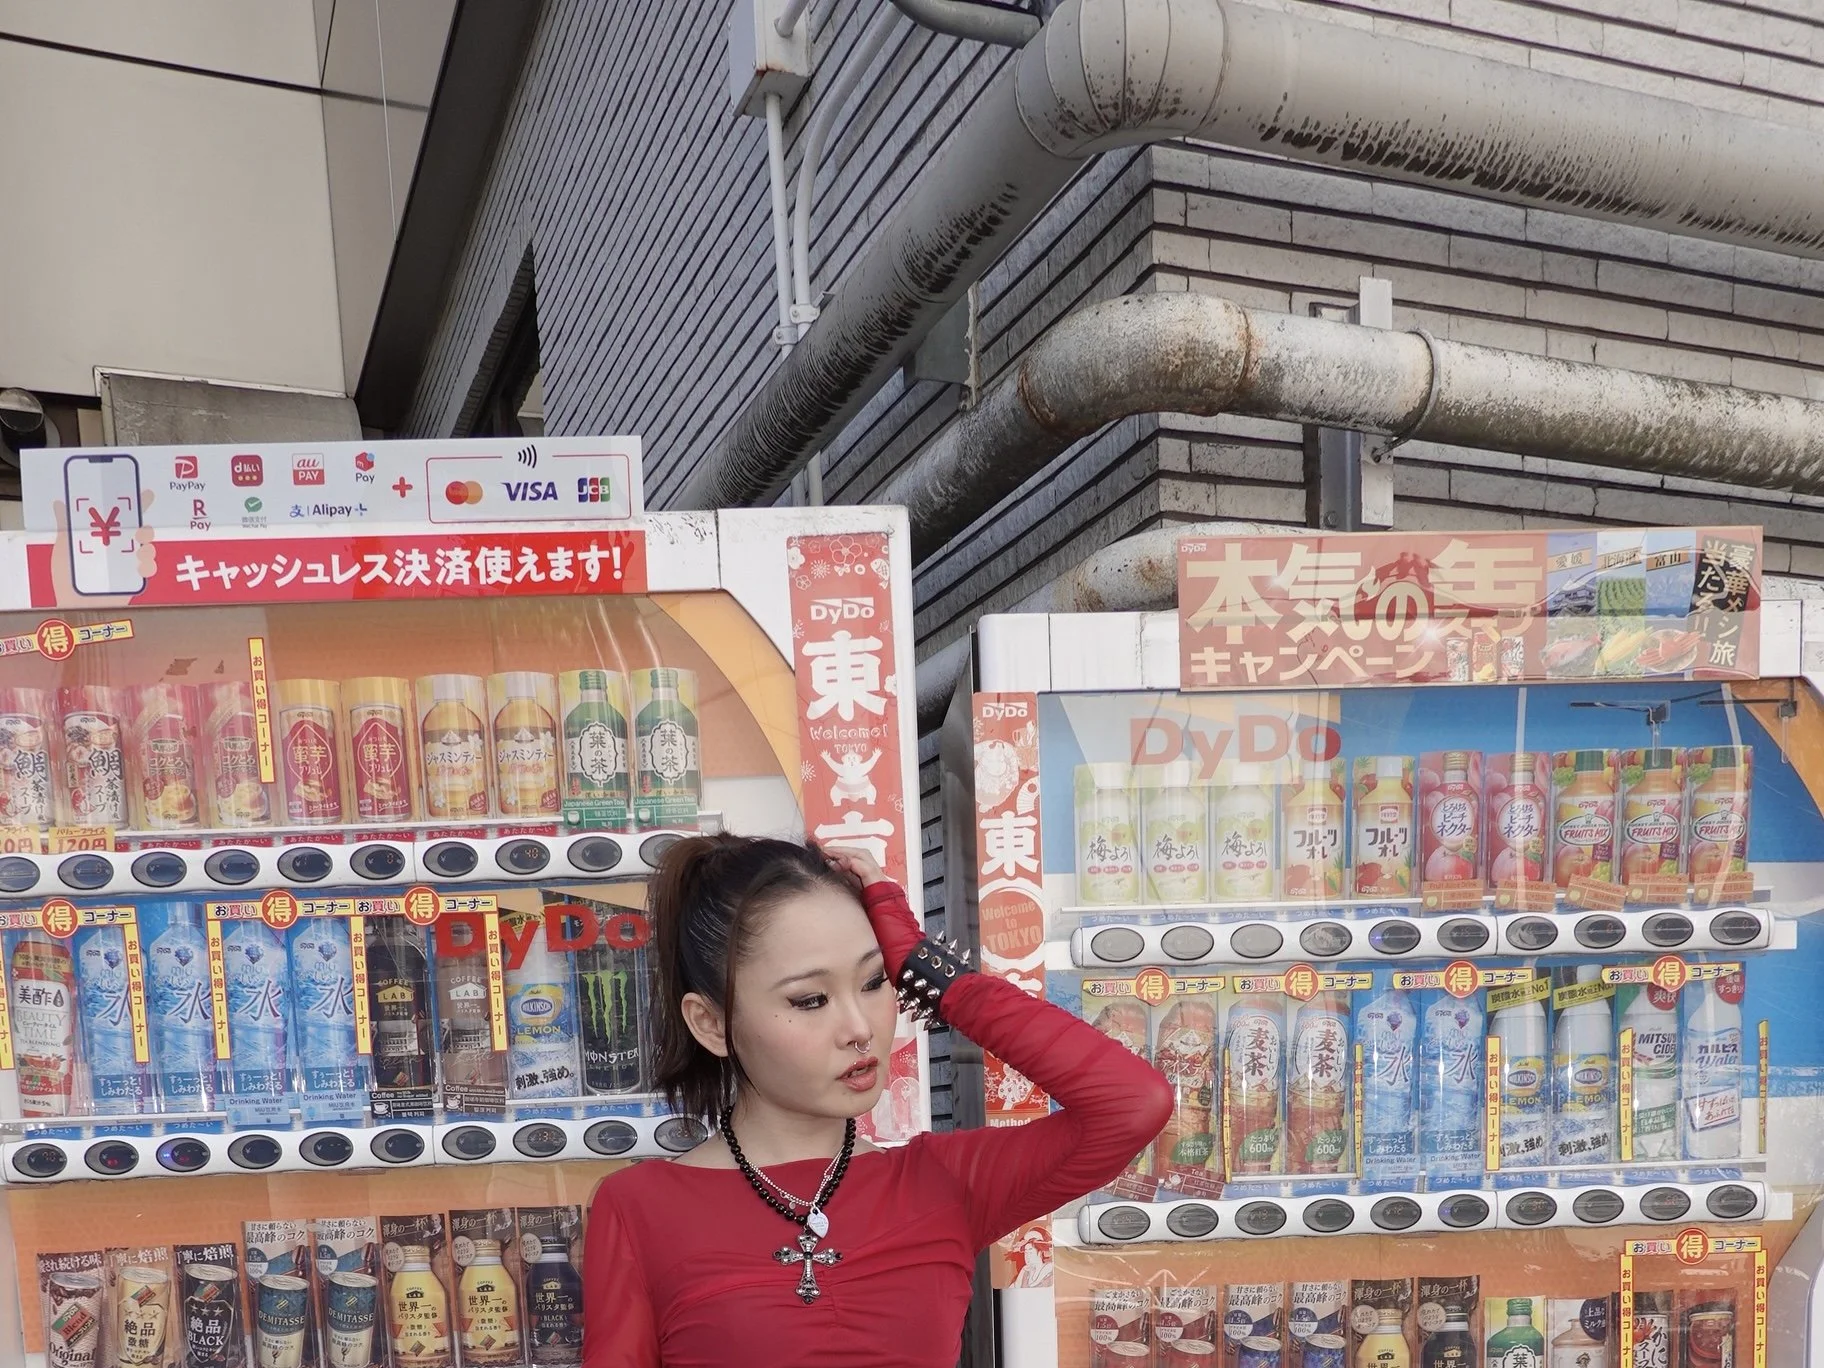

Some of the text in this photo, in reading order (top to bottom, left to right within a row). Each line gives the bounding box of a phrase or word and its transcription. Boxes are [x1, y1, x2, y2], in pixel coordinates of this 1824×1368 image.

[297, 457, 319, 468] au
[298, 472, 319, 482] PAY
[355, 473, 375, 483] Pay
[170, 482, 206, 491] PayPay
[501, 482, 558, 501] VISA
[577, 482, 611, 498] JCB
[193, 499, 207, 516] R
[190, 520, 211, 531] Pay
[1181, 543, 1207, 554] DyDo
[1653, 551, 1682, 567] 富山
[810, 598, 875, 624] DyDo
[1190, 644, 1434, 684] キャンペーン
[802, 630, 887, 721] 東
[252, 656, 271, 766] お買い得コーナー
[982, 703, 1028, 720] DyDo
[810, 724, 888, 741] Welcome!
[499, 749, 554, 762] ジャスミンティー
[589, 731, 608, 775] 葉の茶
[660, 729, 679, 773] 葉の茶
[834, 743, 867, 754] TOKYO
[1130, 715, 1342, 780] DyDo
[427, 751, 482, 764] ジャスミンティー
[1294, 828, 1337, 848] フルーツ
[1366, 827, 1408, 846] フルーツ
[1437, 823, 1472, 837] ネクター
[1502, 824, 1539, 838] ネクター
[1564, 828, 1608, 839] FRUITS MIX
[1632, 826, 1676, 837] FRUITS MIX
[1699, 825, 1743, 835] FRUITS MIX
[980, 810, 1040, 877] 東
[982, 900, 1035, 922] Welcome
[1006, 918, 1018, 929] to
[987, 925, 1042, 953] TOKYO
[353, 933, 367, 1038] お買い得コーナー
[450, 975, 482, 984] COFFEE
[488, 930, 502, 1035] お買い得コーナー
[128, 941, 145, 1047] お買い得コーナー
[210, 938, 226, 1043] お買い得コーナー
[311, 976, 353, 1018] 水
[169, 981, 212, 1024] 水
[238, 979, 282, 1021] 水
[16, 1010, 67, 1027] BEAUTY
[22, 1026, 57, 1040] TIME
[517, 1026, 561, 1035] LEMON
[1246, 1028, 1270, 1076] 麦茶
[1313, 1029, 1337, 1078] 麦茶
[1698, 1043, 1738, 1055] カルピス
[1378, 1046, 1412, 1086] 水
[1445, 1044, 1477, 1084] 水
[100, 1086, 143, 1096] しみわたる
[172, 1084, 214, 1093] しみわたる
[241, 1081, 283, 1091] しみわたる
[313, 1079, 355, 1089] しみわたる
[230, 1096, 282, 1106] Drinking Water
[304, 1093, 335, 1101] Drinking
[1569, 1094, 1608, 1105] LEMON
[1366, 1157, 1396, 1165] Drinking
[259, 1311, 305, 1326] DEMITASSE
[328, 1307, 374, 1323] DEMITASSE
[124, 1319, 155, 1337] 絶品
[190, 1316, 221, 1334] 絶品
[189, 1332, 224, 1346] BLACK
[50, 1342, 97, 1366] Original
